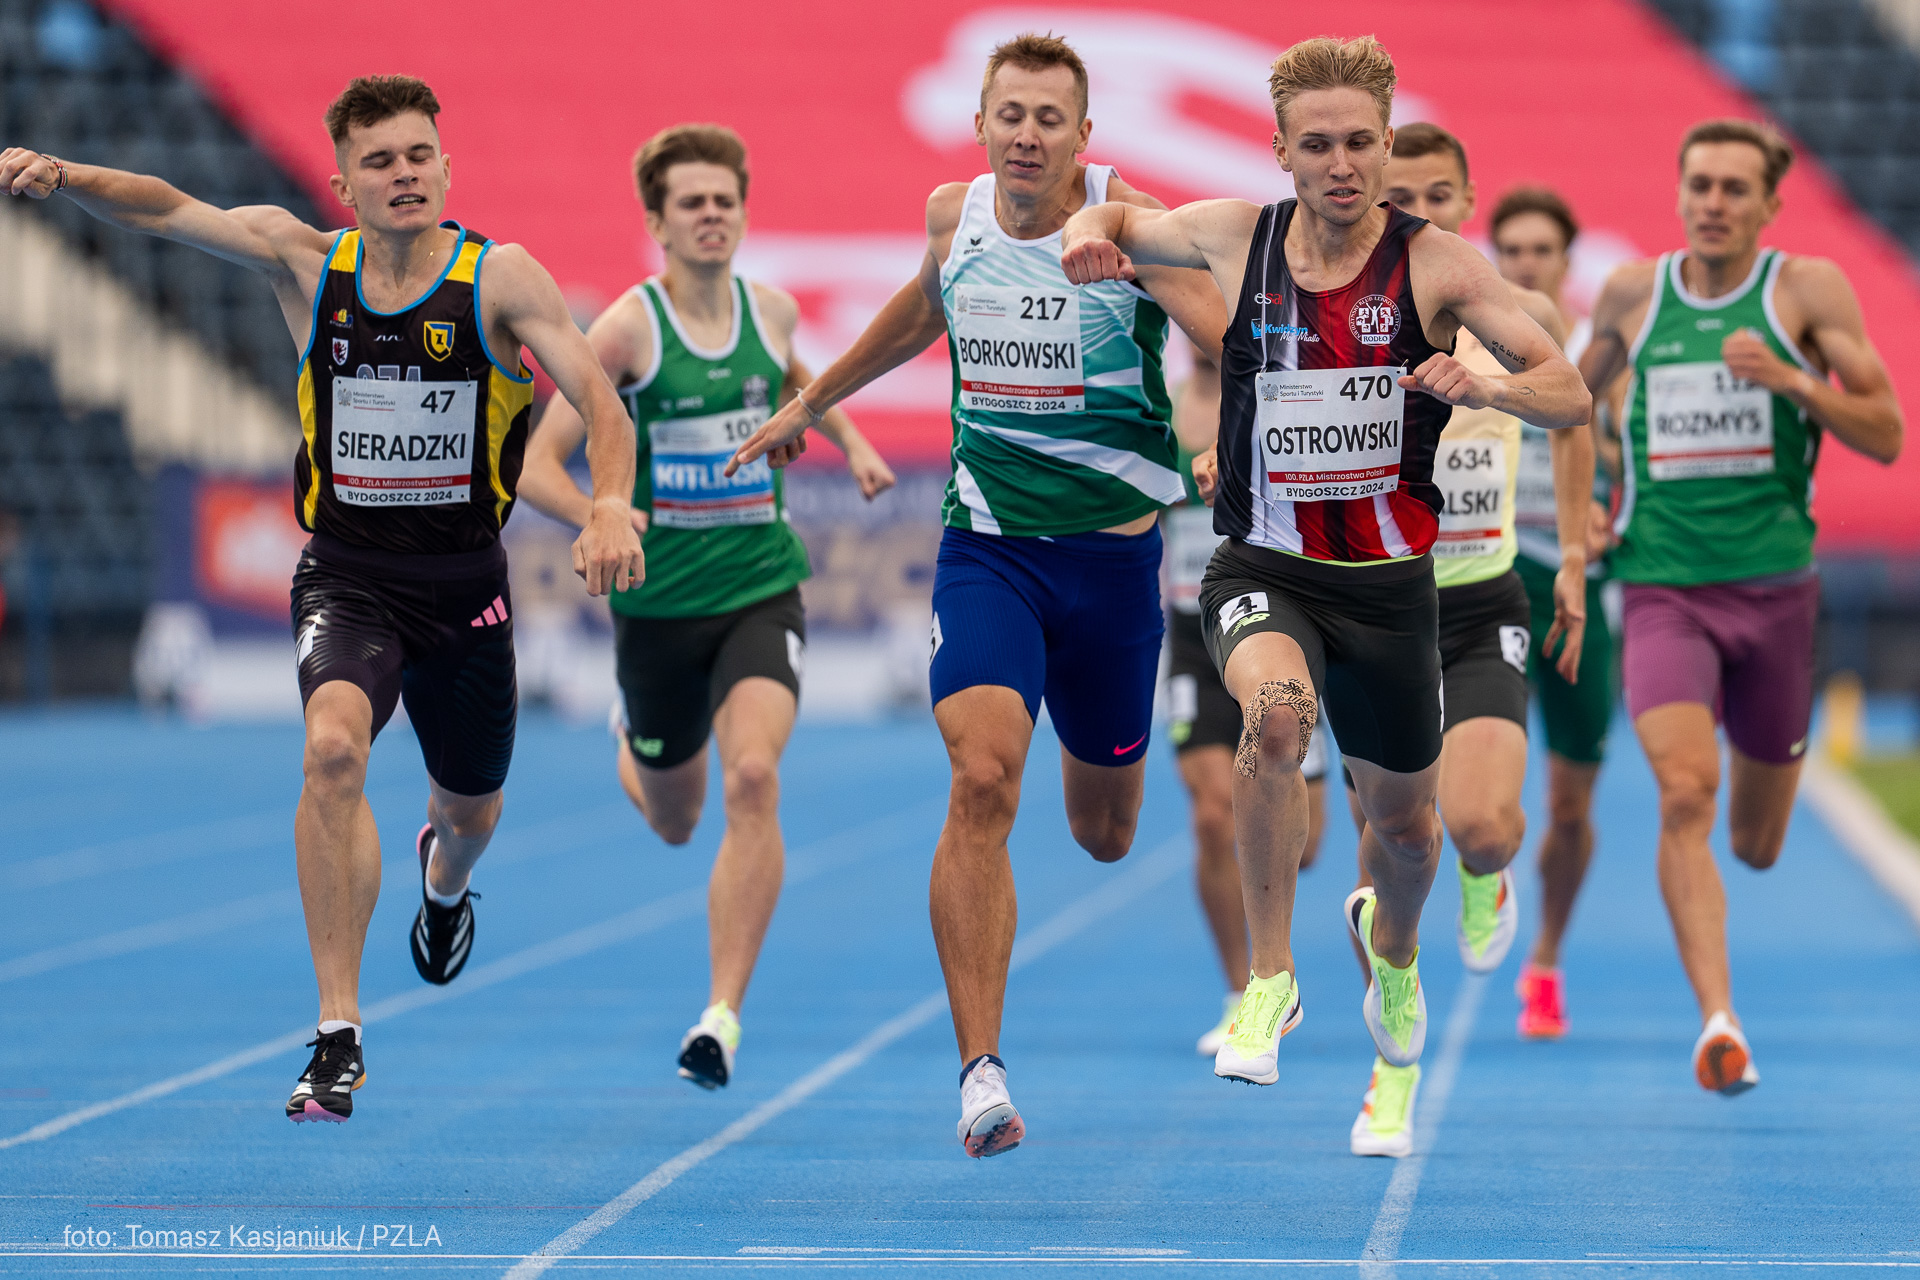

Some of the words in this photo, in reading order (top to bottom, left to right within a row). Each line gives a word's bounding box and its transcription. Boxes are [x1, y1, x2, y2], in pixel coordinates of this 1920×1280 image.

[1020, 296, 1067, 320] 217
[1265, 324, 1308, 336] Kwidzyn
[959, 337, 1075, 369] BORKOWSKI
[1492, 340, 1527, 366] SPEED
[971, 383, 983, 392] 100.
[984, 385, 998, 393] PZLA
[999, 386, 1039, 395] Mistrzostwa
[1300, 390, 1324, 398] Turystyki
[1340, 375, 1392, 401] 470
[420, 390, 456, 414] 47
[971, 396, 1032, 410] BYDGOSZCZ
[1034, 401, 1066, 410] 2024
[337, 430, 466, 461] SIERADZKI
[1266, 420, 1398, 455] OSTROWSKI
[1447, 448, 1493, 470] 634
[348, 477, 360, 486] 100.
[362, 478, 380, 487] PZLA
[382, 478, 430, 488] Mistrzostwa
[430, 478, 452, 486] Polski
[1300, 474, 1314, 482] PZLA
[1316, 472, 1364, 481] Mistrzostwa
[1366, 468, 1386, 478] Polski
[348, 491, 422, 502] BYDGOSZCZ
[424, 490, 452, 501] 2024
[1286, 486, 1358, 498] BYDGOSZCZ
[1360, 482, 1384, 494] 2024
[1440, 488, 1499, 515] LSKI
[1228, 596, 1258, 621] 4
